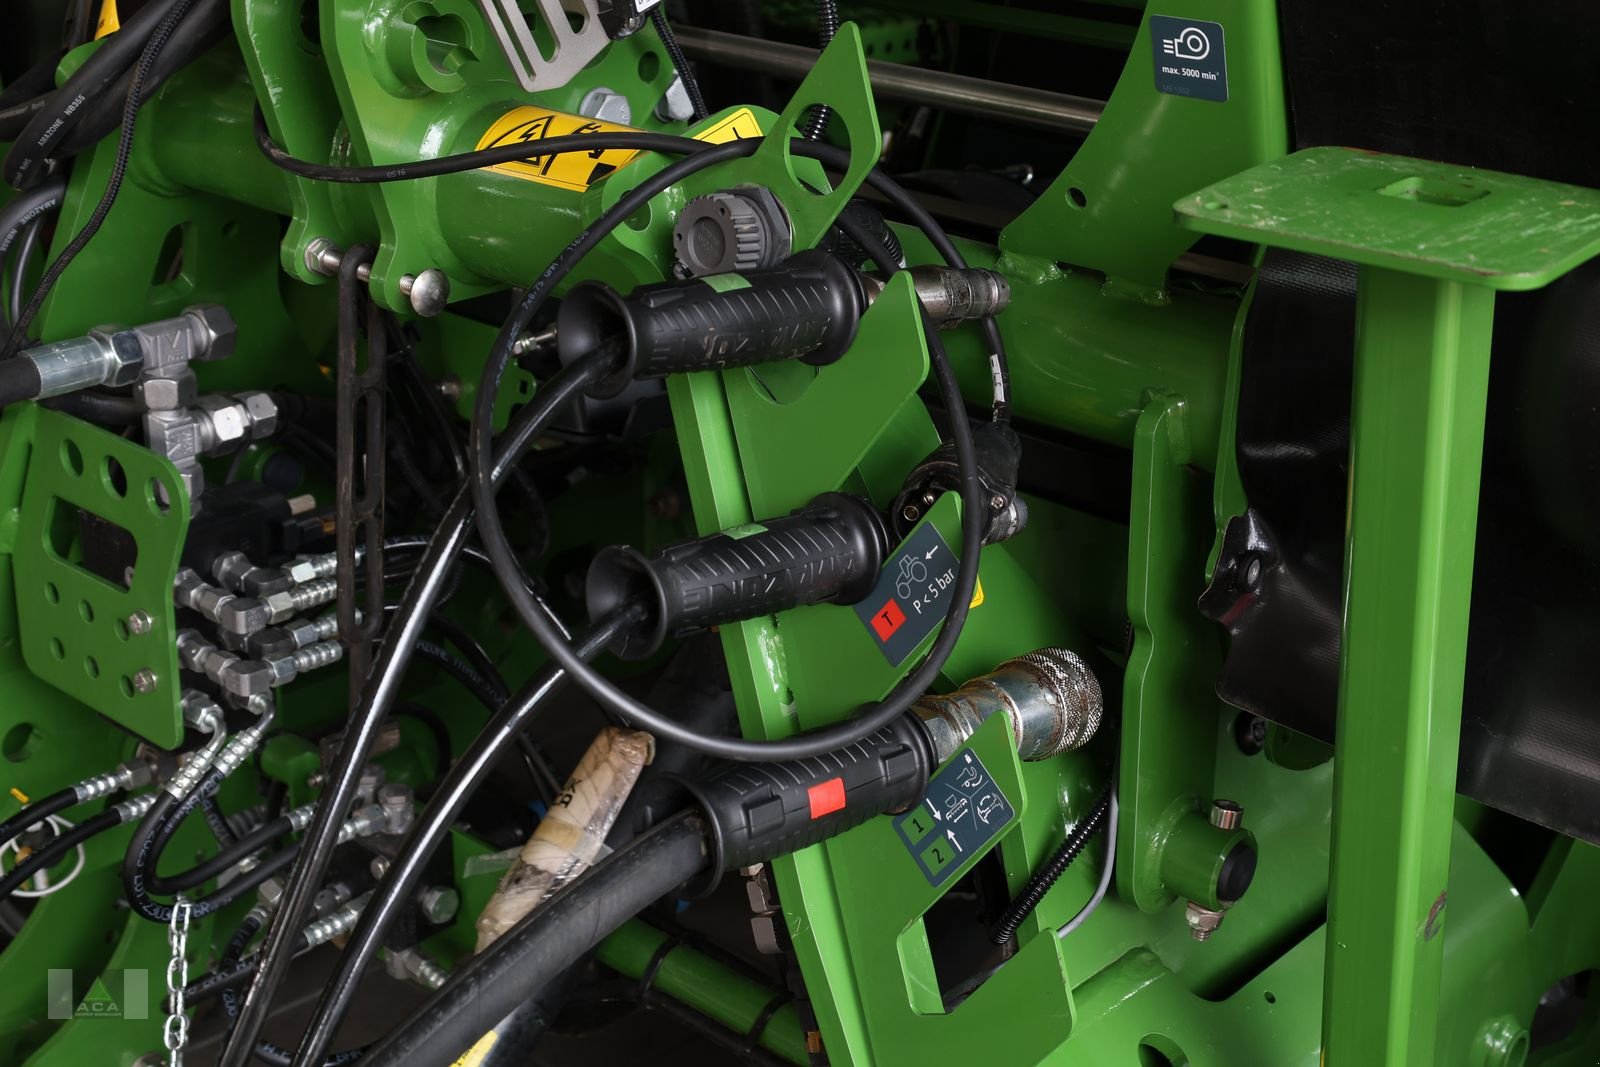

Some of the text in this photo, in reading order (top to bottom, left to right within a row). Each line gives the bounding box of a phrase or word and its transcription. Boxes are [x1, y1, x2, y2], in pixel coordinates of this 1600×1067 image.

[1161, 66, 1180, 75] max.
[1181, 67, 1200, 78] 5000
[37, 94, 86, 147] AMAZONE NB355
[19, 199, 56, 226] AMAZONE
[913, 600, 922, 614] P
[928, 583, 938, 598] 5
[935, 568, 955, 590] bar
[881, 611, 893, 626] T
[912, 818, 924, 833] 1
[932, 848, 944, 864] 2
